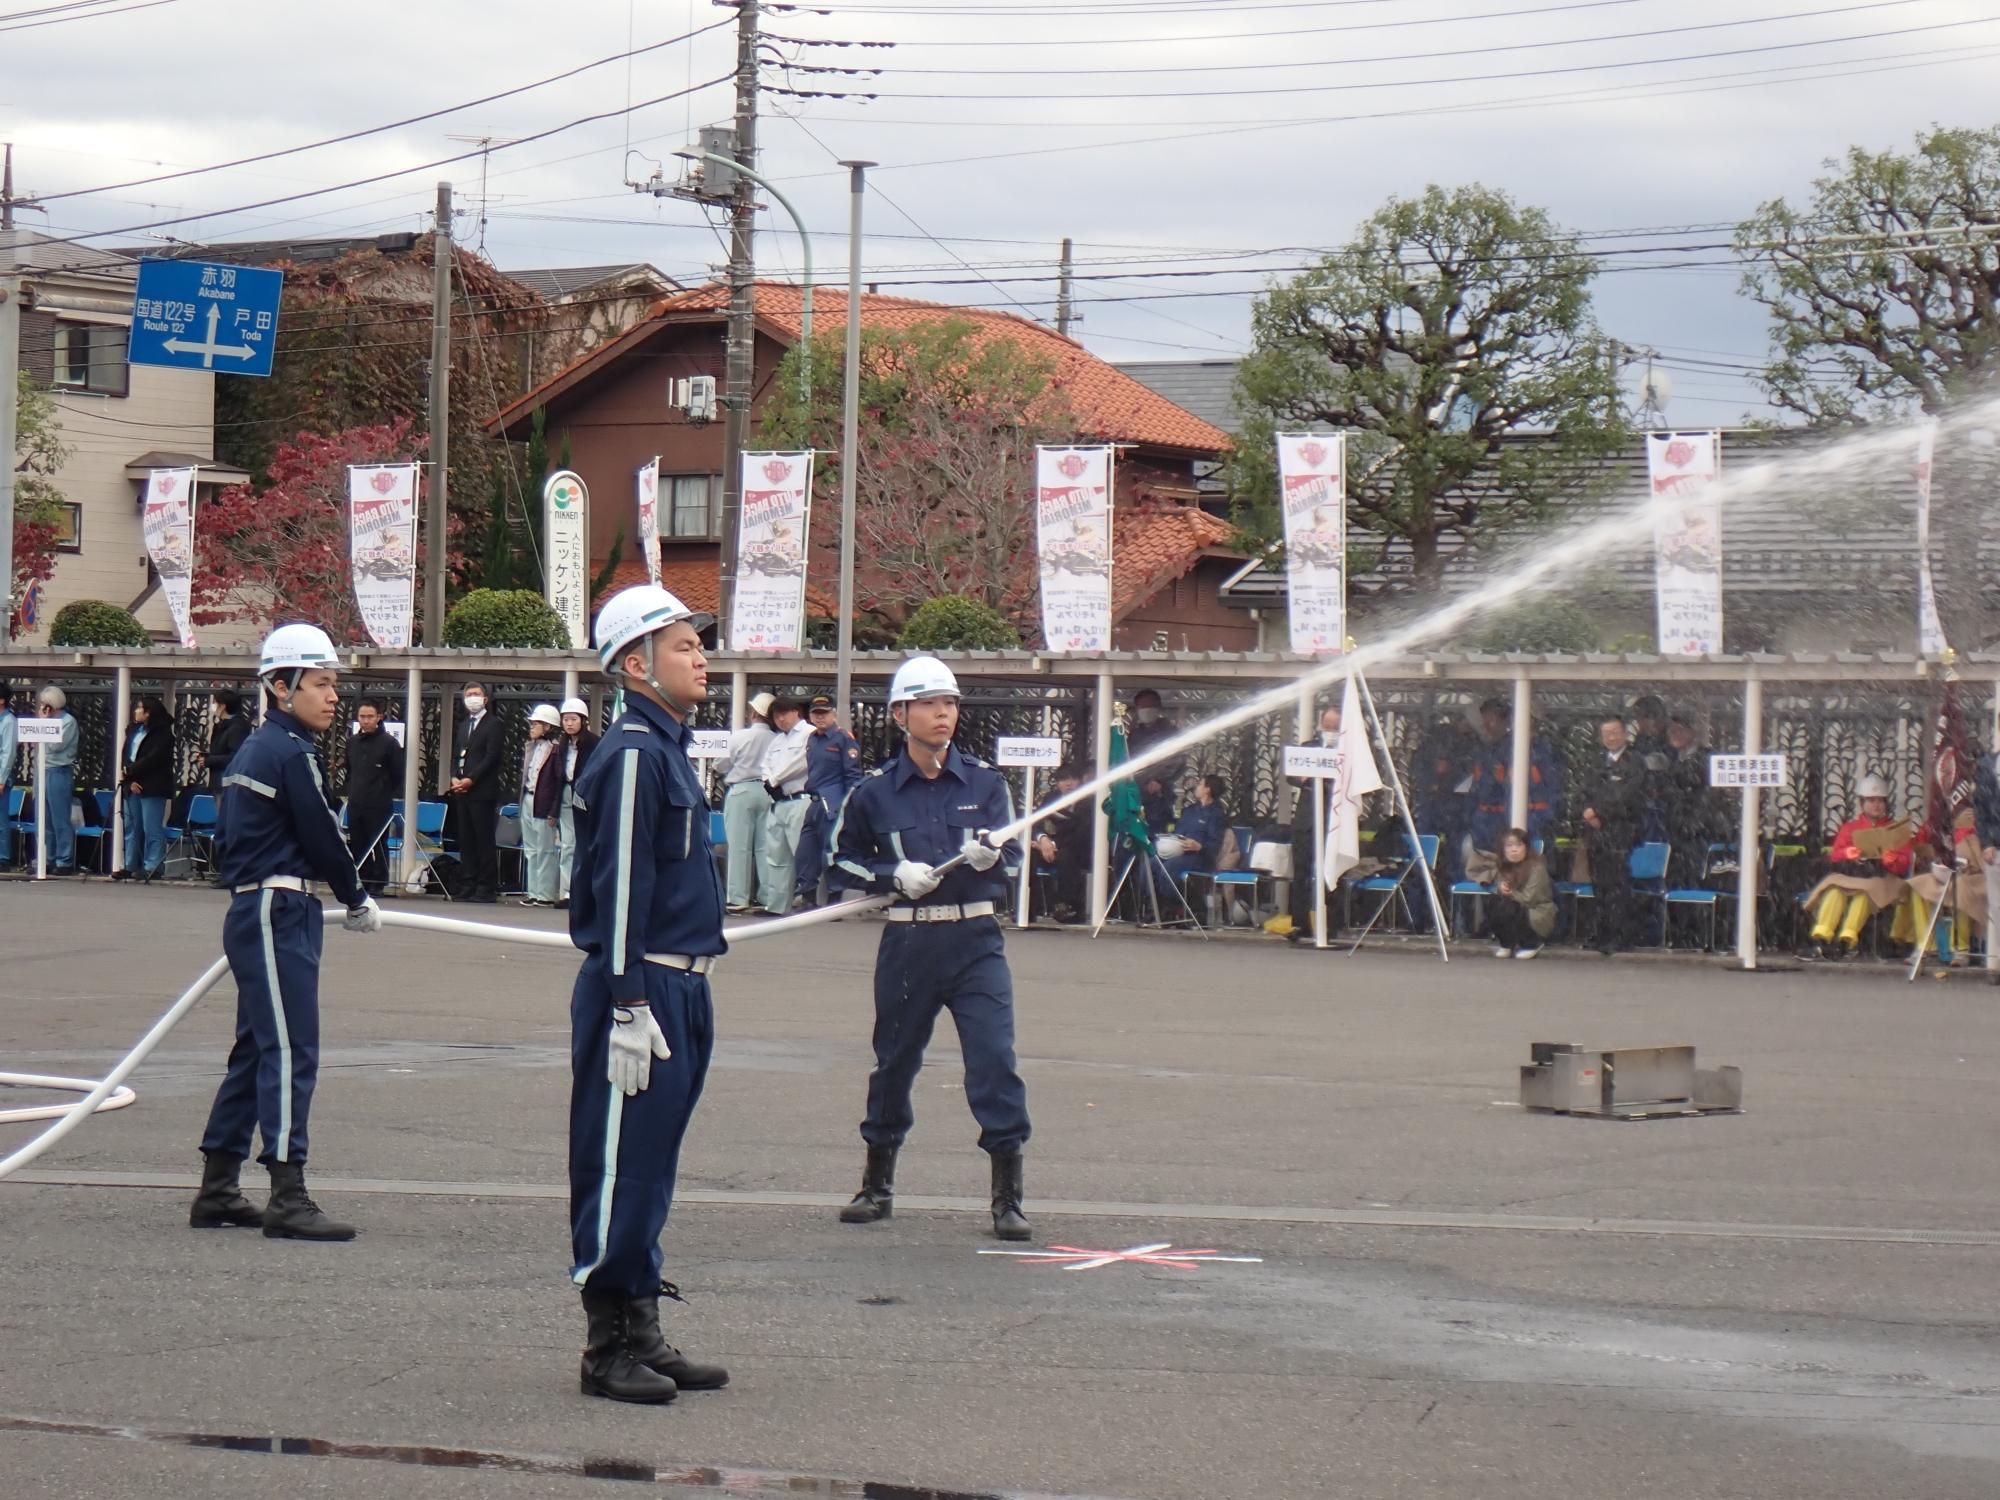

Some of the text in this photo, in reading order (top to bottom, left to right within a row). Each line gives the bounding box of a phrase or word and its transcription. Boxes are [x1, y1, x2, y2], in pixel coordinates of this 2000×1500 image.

[201, 267, 237, 288] 赤羽
[198, 287, 236, 300] Akabane
[137, 298, 196, 322] 国道122号
[143, 319, 185, 333] Route 122
[234, 308, 272, 330] 戸田
[241, 329, 262, 341] Toda
[554, 511, 579, 520] NIKKEN
